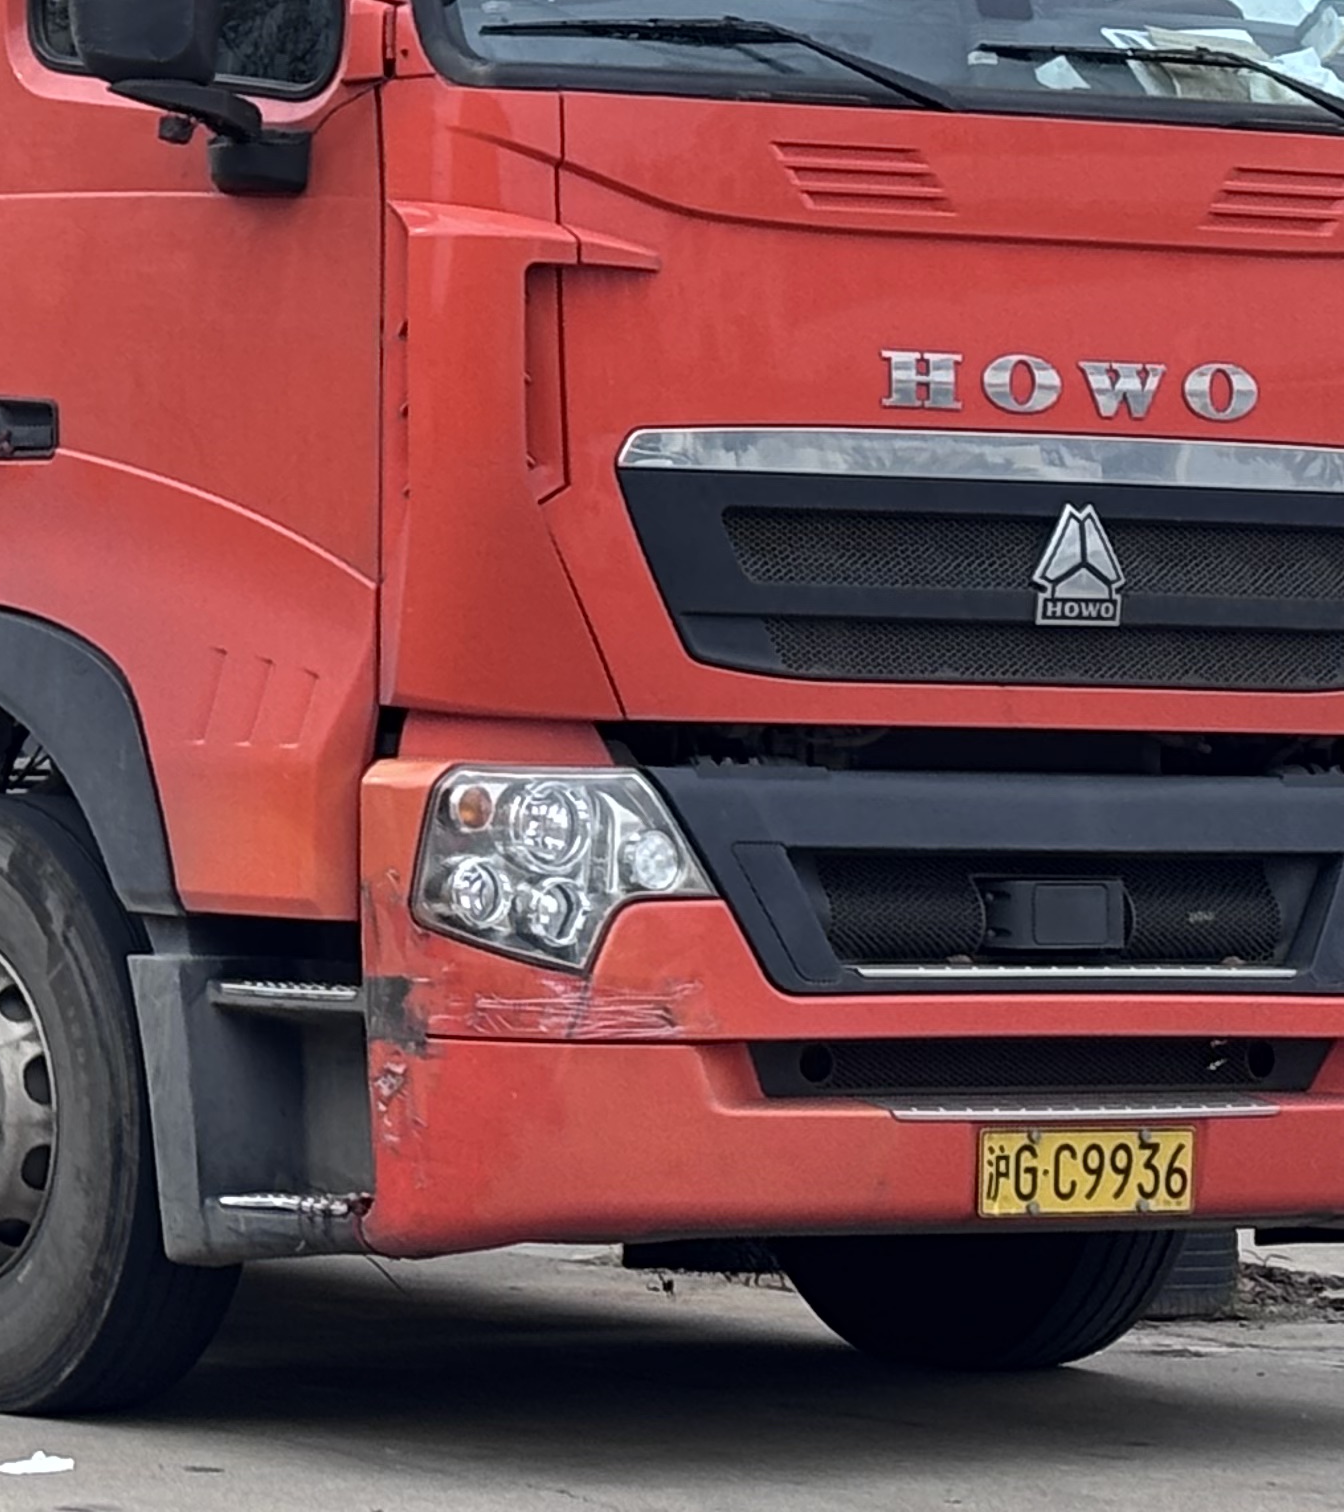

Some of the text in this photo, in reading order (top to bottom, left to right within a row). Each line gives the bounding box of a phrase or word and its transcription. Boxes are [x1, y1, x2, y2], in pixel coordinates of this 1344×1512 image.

[880, 350, 1259, 421] HOWO
[1046, 600, 1114, 619] HOWO
[986, 1142, 1188, 1202] 沪G·C9936
